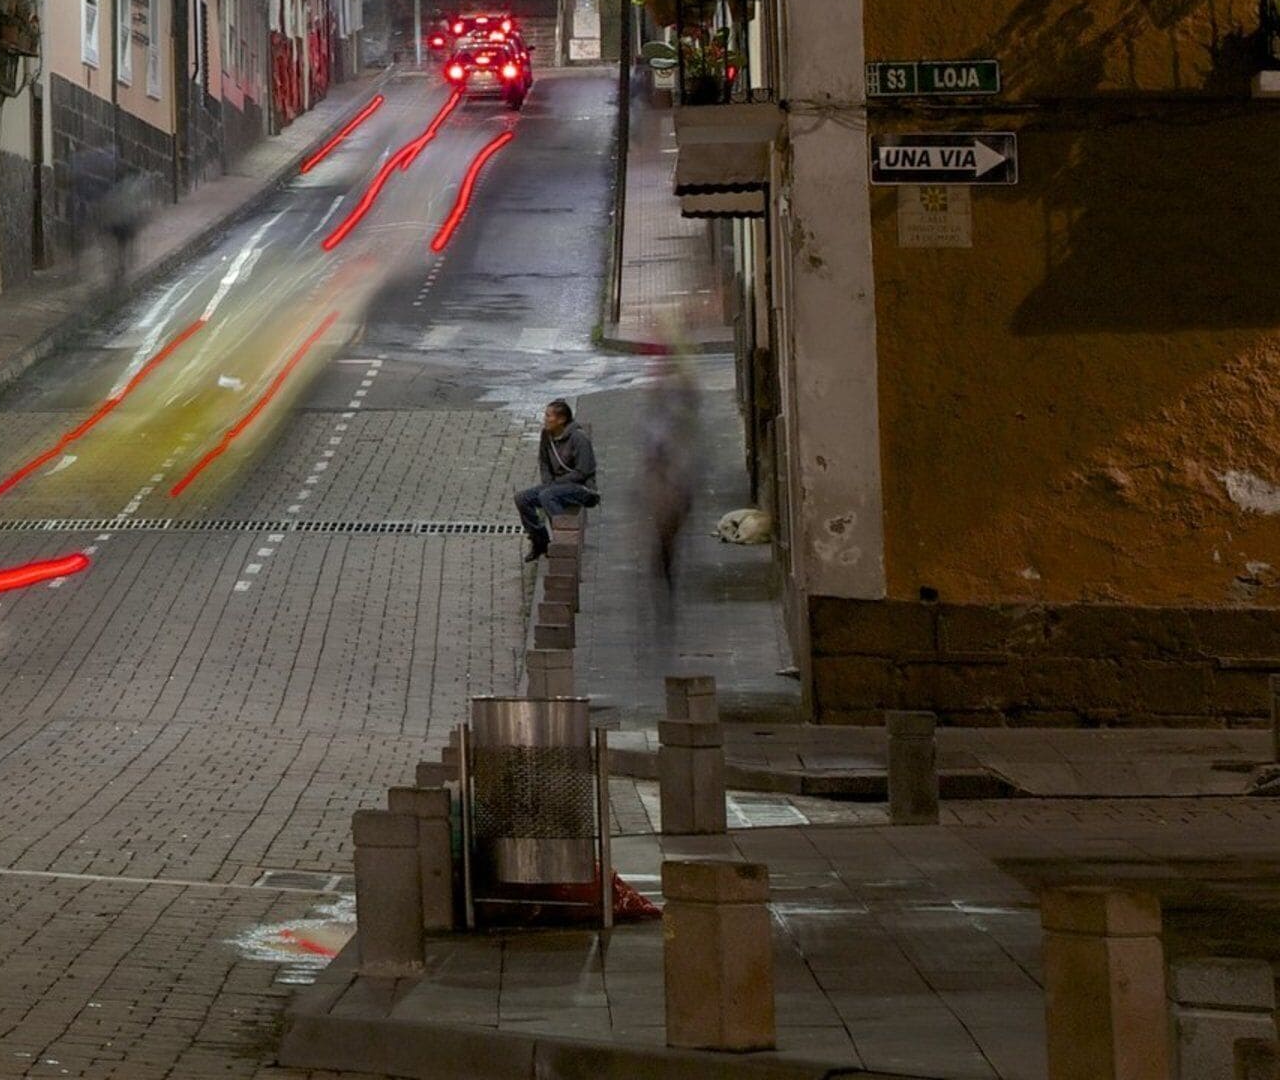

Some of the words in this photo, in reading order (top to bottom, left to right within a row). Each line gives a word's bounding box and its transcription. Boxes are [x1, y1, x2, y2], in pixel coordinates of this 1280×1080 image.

[887, 70, 906, 89] S3
[933, 68, 980, 87] LOJA
[885, 150, 931, 168] UNA
[940, 150, 977, 168] VIA
